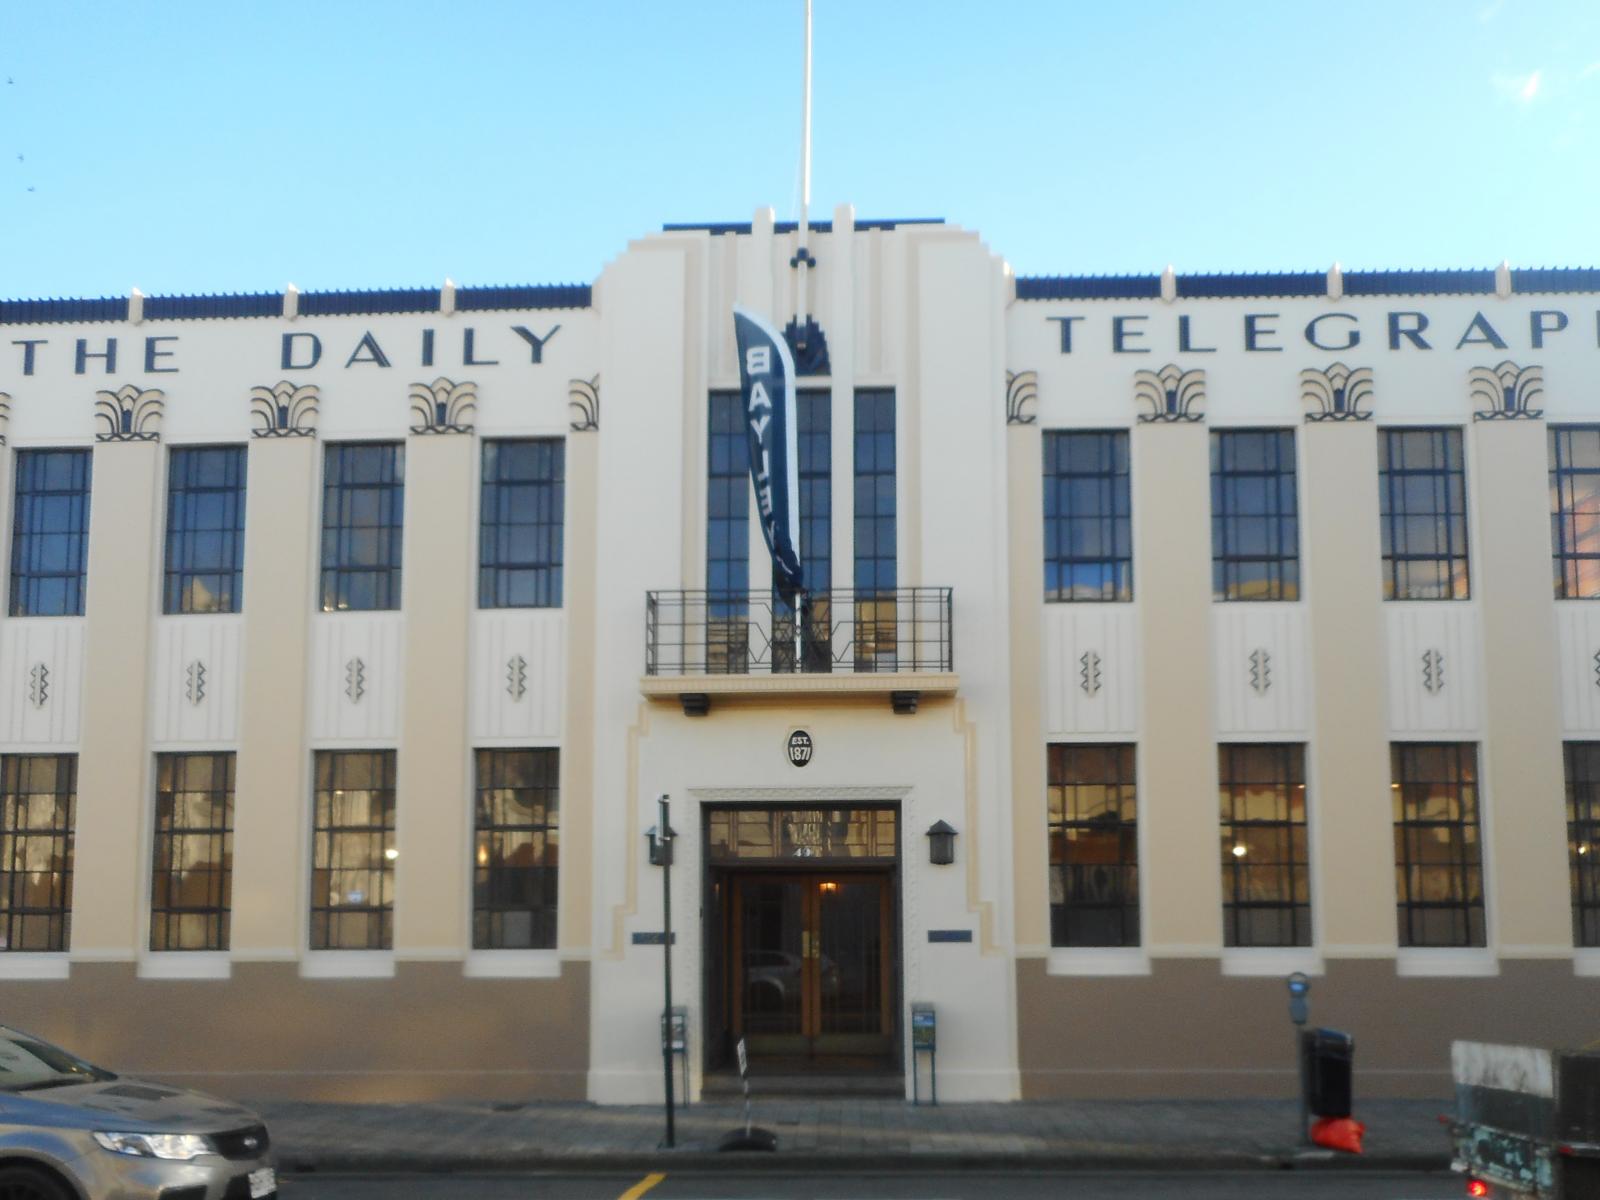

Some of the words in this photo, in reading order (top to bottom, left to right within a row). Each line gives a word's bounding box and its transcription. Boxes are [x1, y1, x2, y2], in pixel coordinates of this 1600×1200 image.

[11, 336, 180, 376] THE
[281, 324, 562, 371] DAILY
[1046, 310, 1600, 354] TELEGRAP
[791, 736, 810, 745] EST.
[790, 746, 811, 761] 1871
